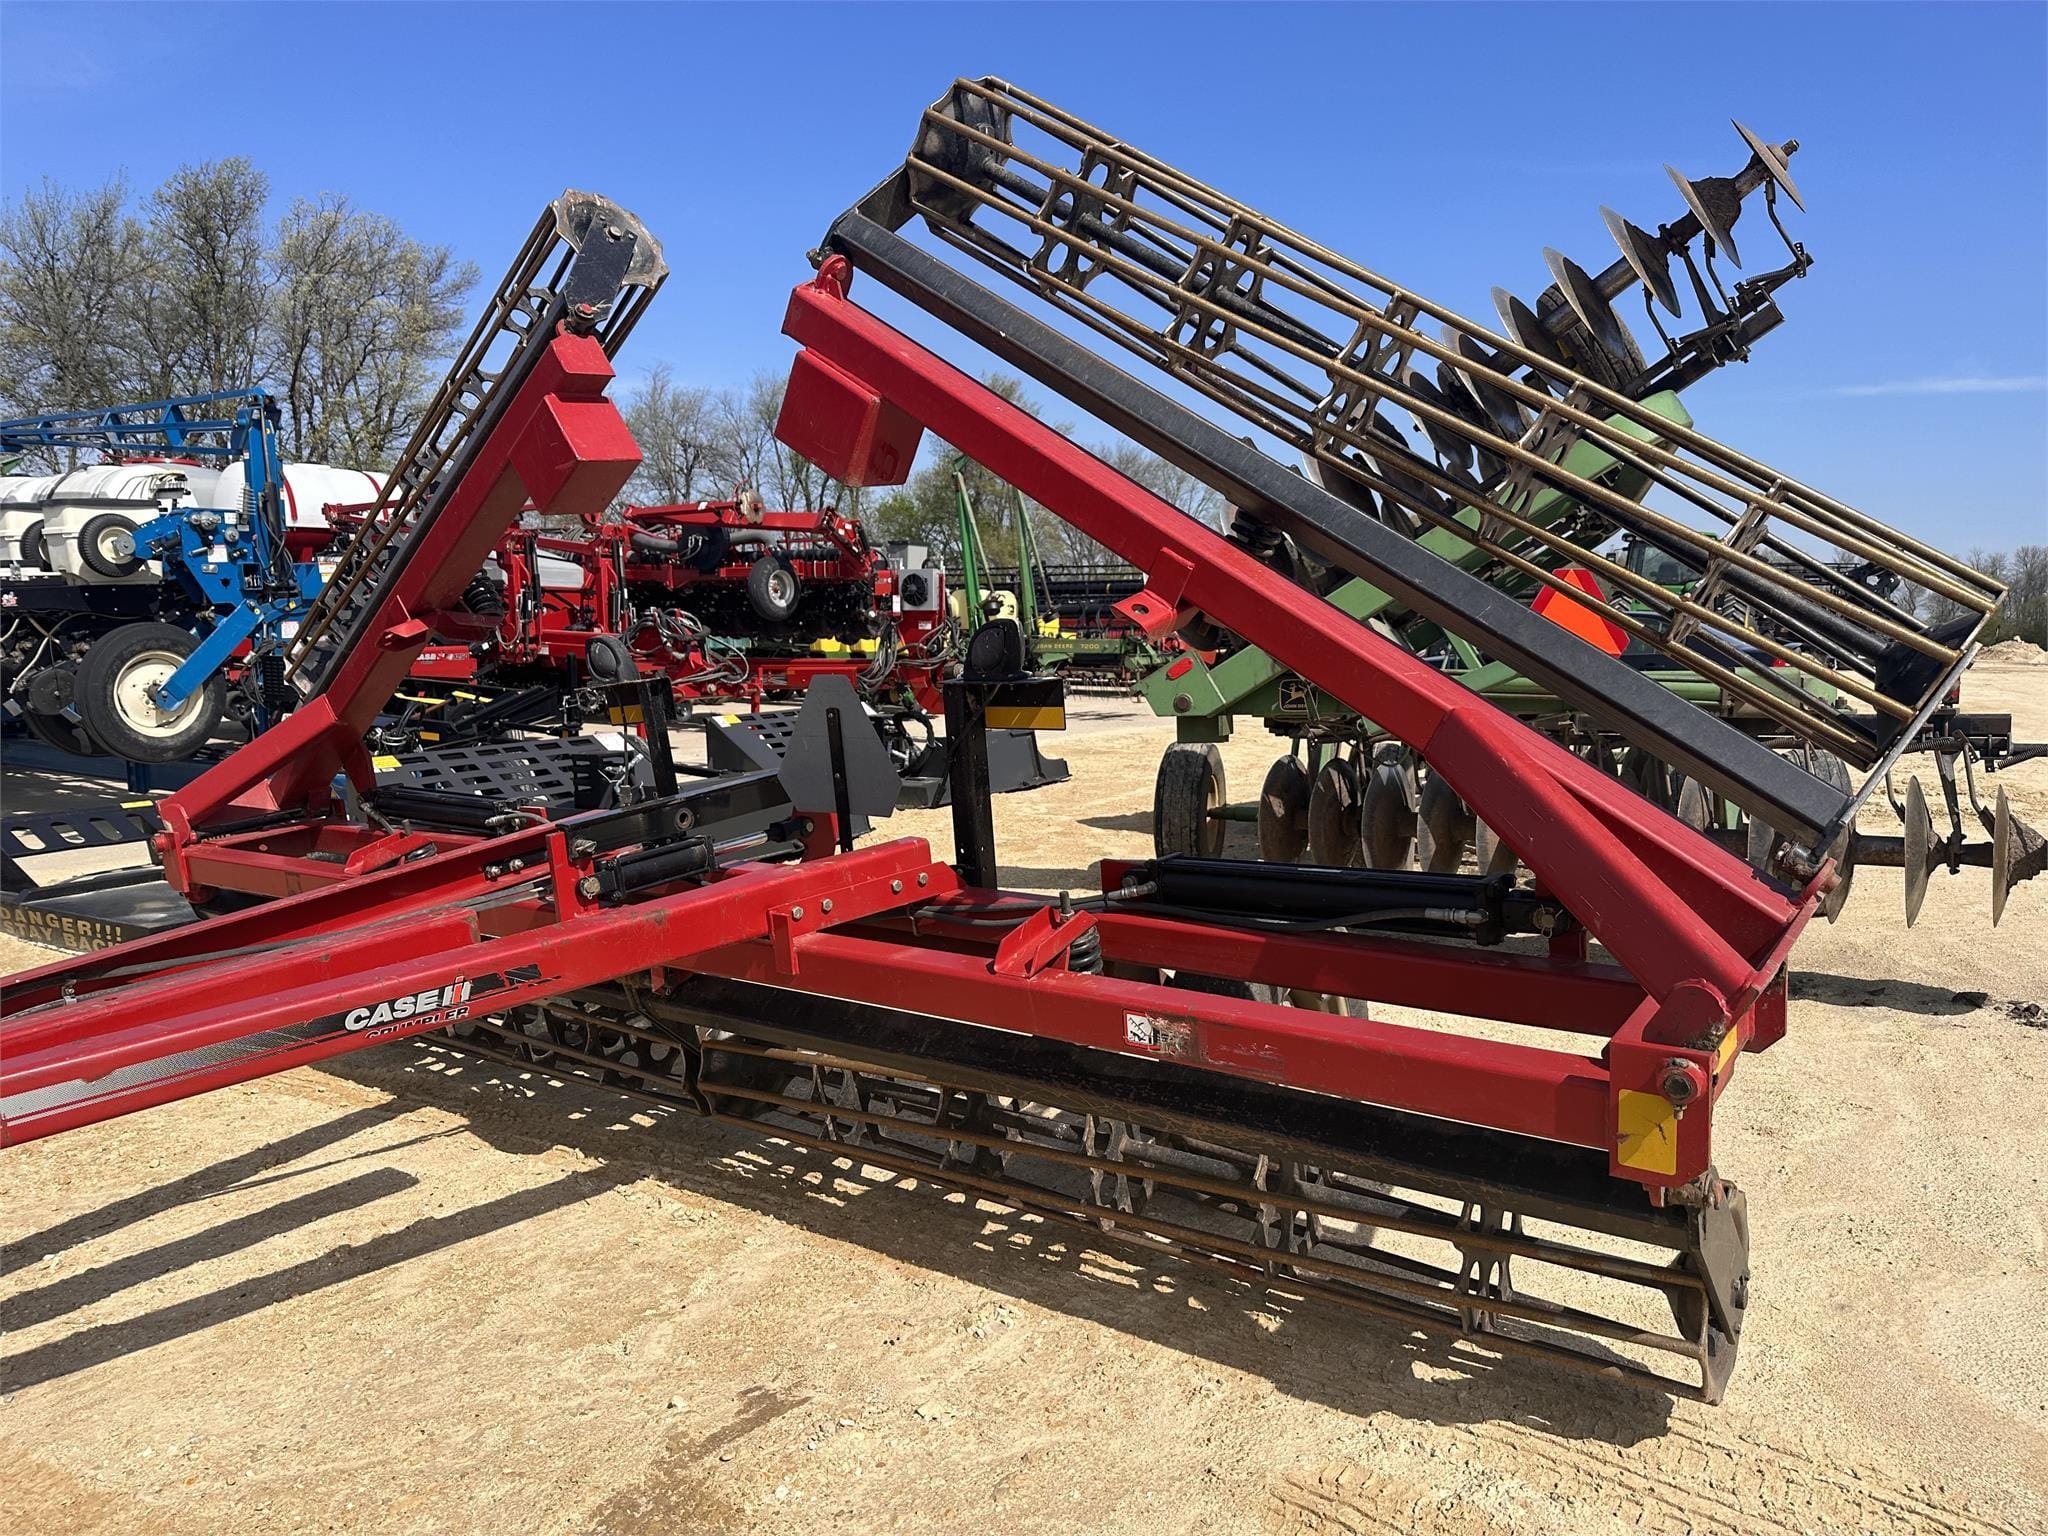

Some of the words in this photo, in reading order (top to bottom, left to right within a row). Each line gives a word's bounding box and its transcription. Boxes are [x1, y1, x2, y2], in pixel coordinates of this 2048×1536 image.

[0, 906, 122, 942] DANGER!!!
[2, 920, 52, 941] STAY
[344, 989, 440, 1032] CASE
